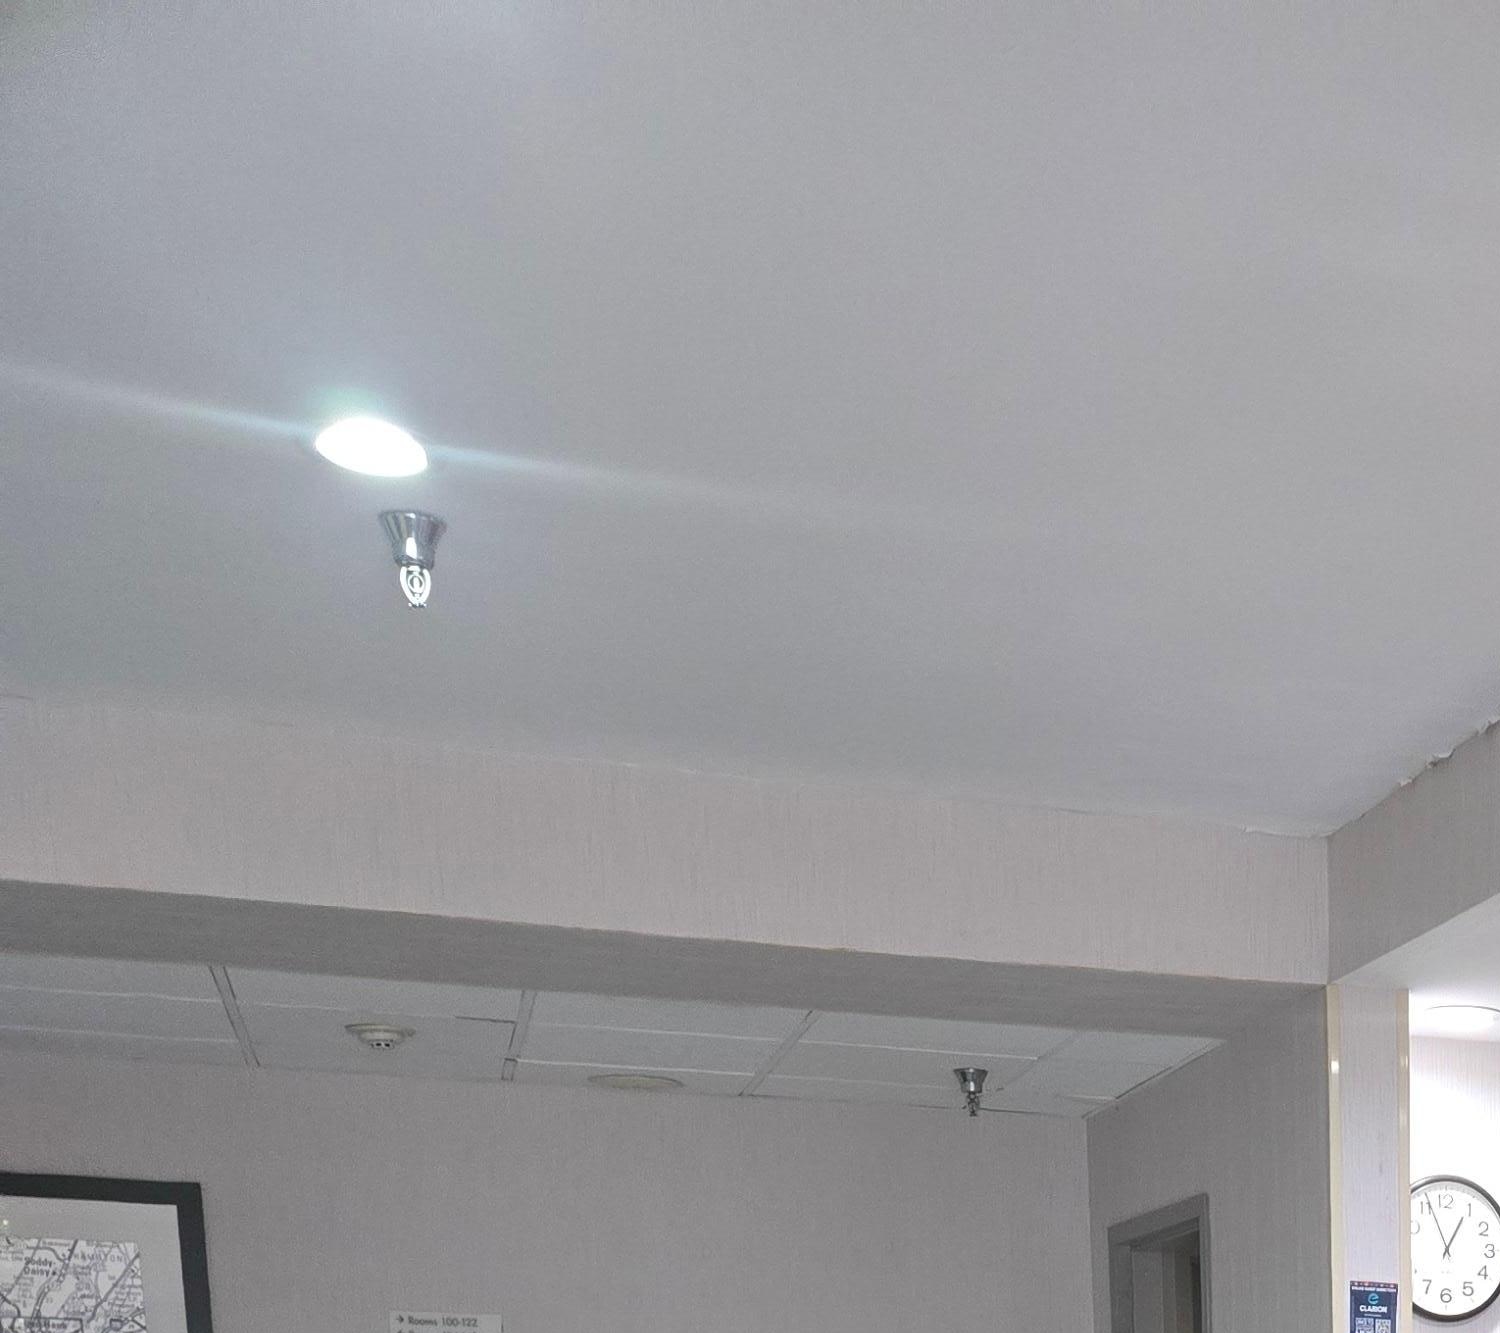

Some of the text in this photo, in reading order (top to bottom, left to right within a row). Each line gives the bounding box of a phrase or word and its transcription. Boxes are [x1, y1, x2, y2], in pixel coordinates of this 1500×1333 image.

[1420, 1200, 1432, 1216] 11
[1438, 1193, 1454, 1210] 12
[1467, 1202, 1473, 1218] 1
[1478, 1220, 1490, 1237] 2
[1483, 1243, 1496, 1259] 3
[1477, 1265, 1489, 1280] 4
[1421, 1279, 1432, 1295] 7
[1440, 1287, 1453, 1303] 6
[1462, 1281, 1475, 1297] 5
[408, 1316, 438, 1327] Rooms
